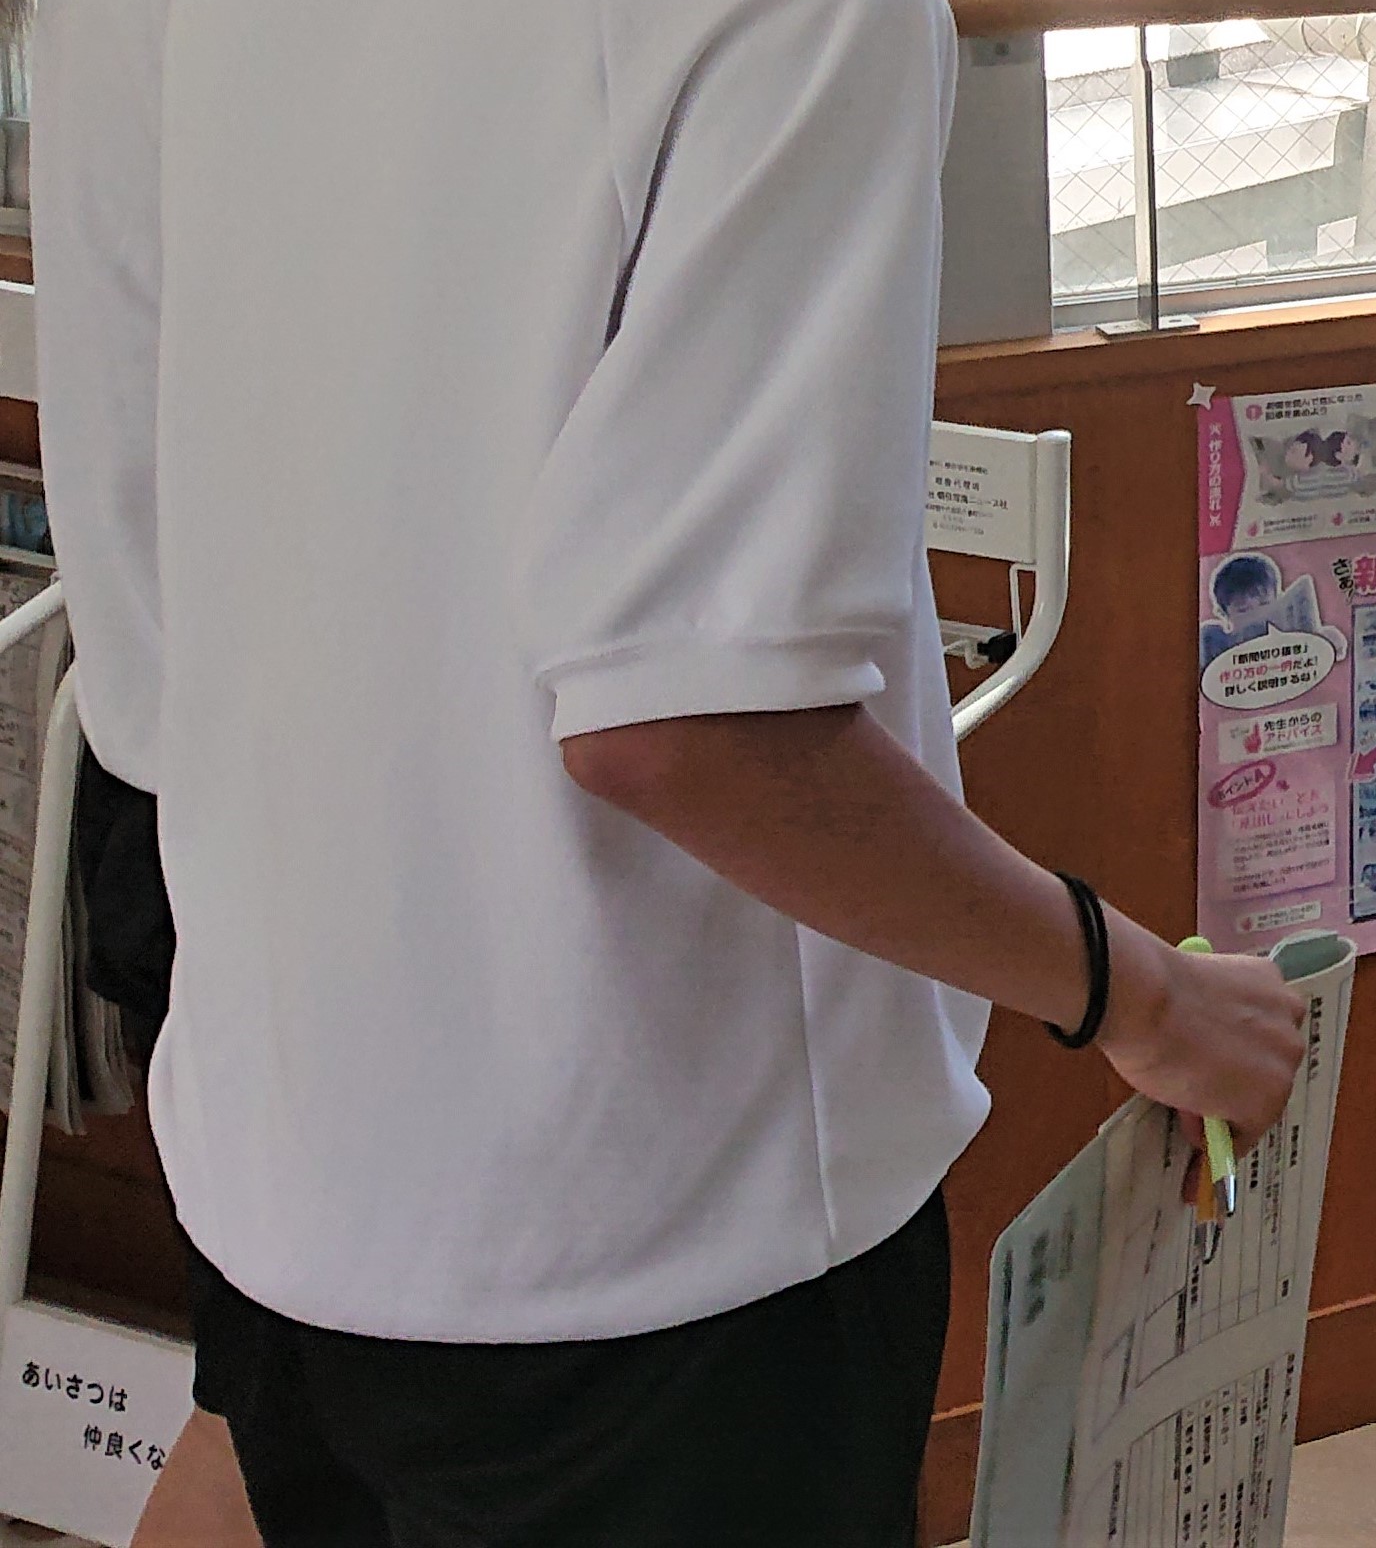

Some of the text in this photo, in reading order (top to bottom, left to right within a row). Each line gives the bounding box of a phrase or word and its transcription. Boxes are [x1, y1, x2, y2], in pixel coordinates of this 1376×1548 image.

[1263, 711, 1323, 732] 先生からの
[21, 1360, 128, 1413] あいさつは
